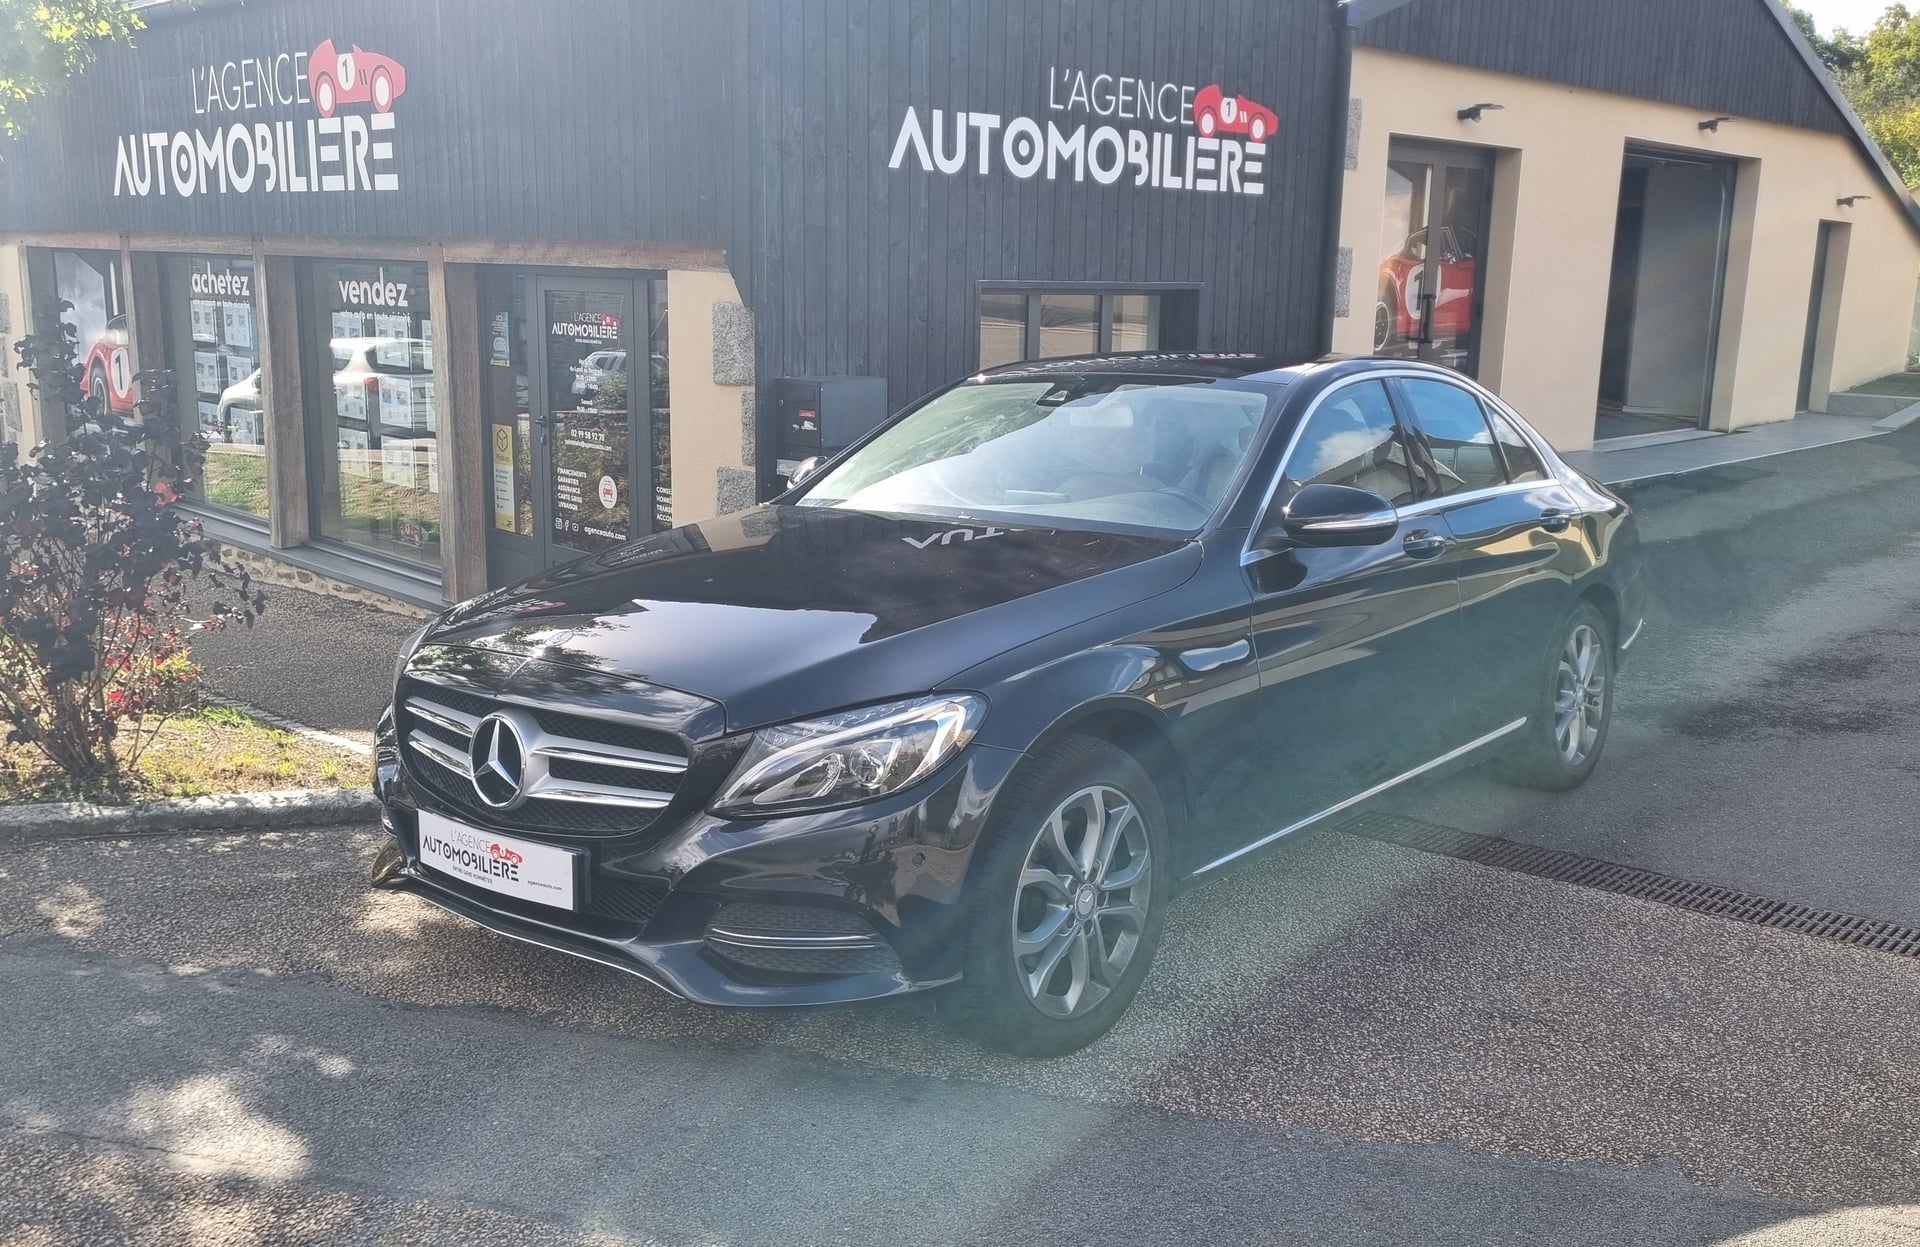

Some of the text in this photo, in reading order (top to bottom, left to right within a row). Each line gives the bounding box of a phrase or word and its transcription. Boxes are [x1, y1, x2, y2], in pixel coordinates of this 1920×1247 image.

[191, 52, 310, 115] L'AGENCE
[1049, 66, 1195, 125] L'AGENCE
[191, 261, 250, 296] achetez
[338, 266, 408, 307] vendez
[573, 312, 601, 324] L'AGENCE
[115, 354, 124, 391] 1
[570, 429, 577, 437] 02
[578, 430, 584, 438] 99
[557, 467, 587, 479] FINANCEMENTS
[557, 476, 579, 486] GARANTIES
[557, 485, 581, 495] ASSURANCE
[584, 526, 627, 542] agenceauto.com
[451, 828, 491, 853] L'AGENCE
[527, 880, 562, 891] agenceauto.com
